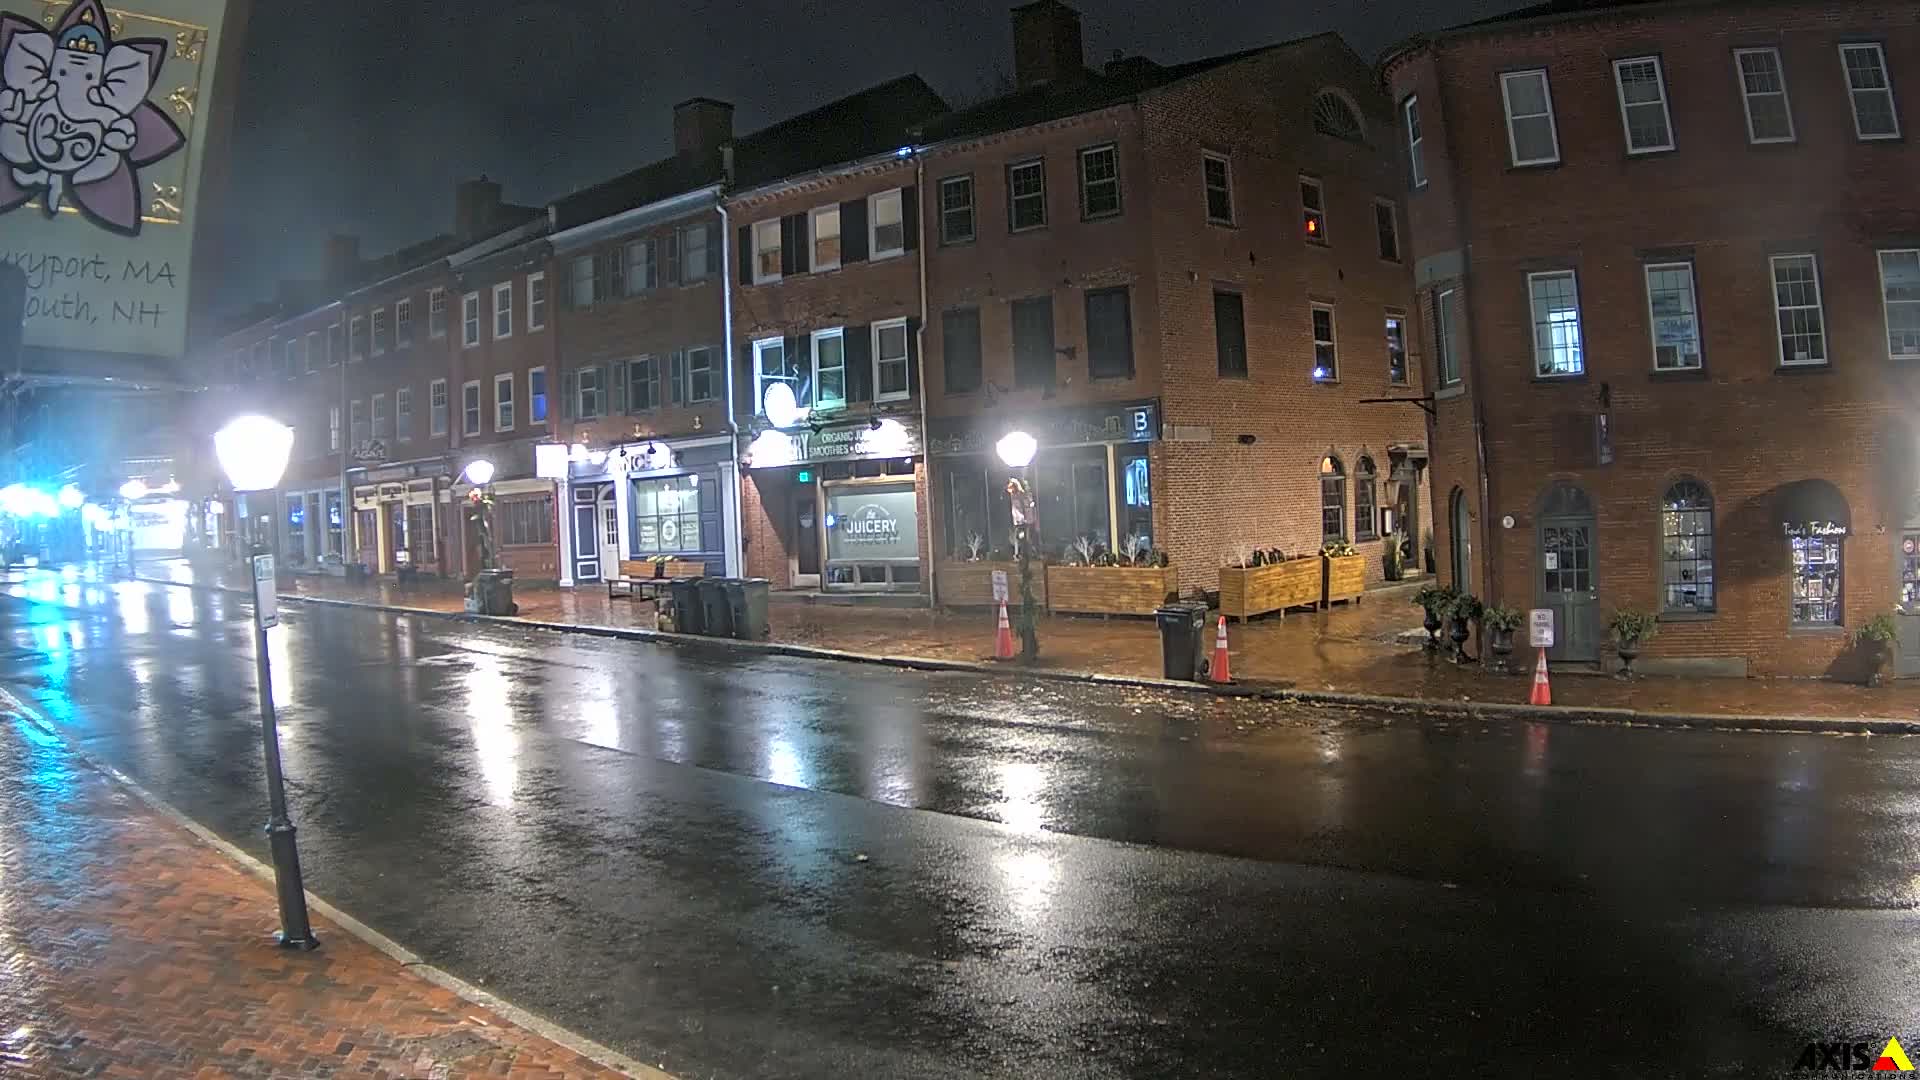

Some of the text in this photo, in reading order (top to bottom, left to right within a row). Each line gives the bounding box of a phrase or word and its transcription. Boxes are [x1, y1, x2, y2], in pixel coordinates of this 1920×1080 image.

[122, 259, 176, 289] MA
[112, 300, 168, 329] NH
[1134, 411, 1148, 431] B
[822, 431, 854, 444] ORGANIC
[809, 443, 849, 457] SMOOTHIES
[846, 519, 897, 534] JUICERY
